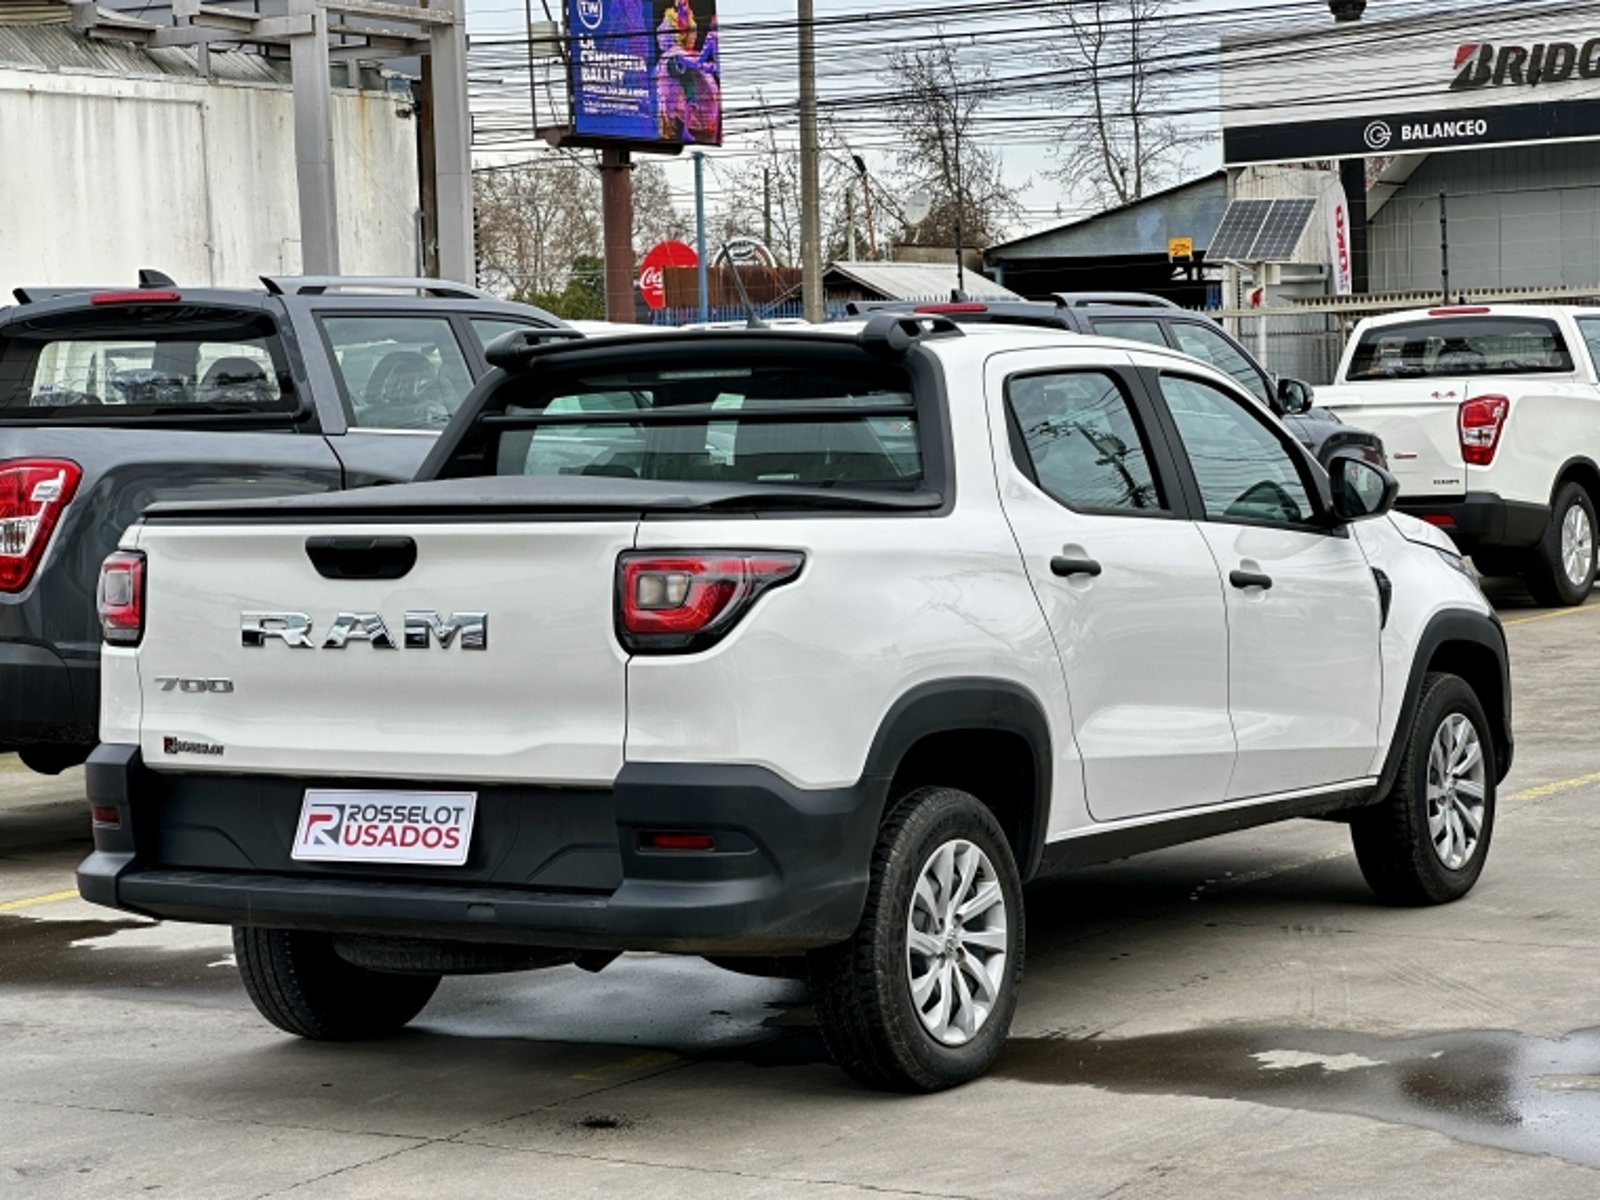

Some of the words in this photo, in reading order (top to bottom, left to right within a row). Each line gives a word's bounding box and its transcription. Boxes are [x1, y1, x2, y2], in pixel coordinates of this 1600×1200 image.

[1401, 119, 1487, 140] BALANCEO
[241, 610, 489, 651] RAM
[153, 676, 235, 693] 700
[346, 804, 465, 826] ROSSELOT
[343, 825, 461, 850] USADOS
